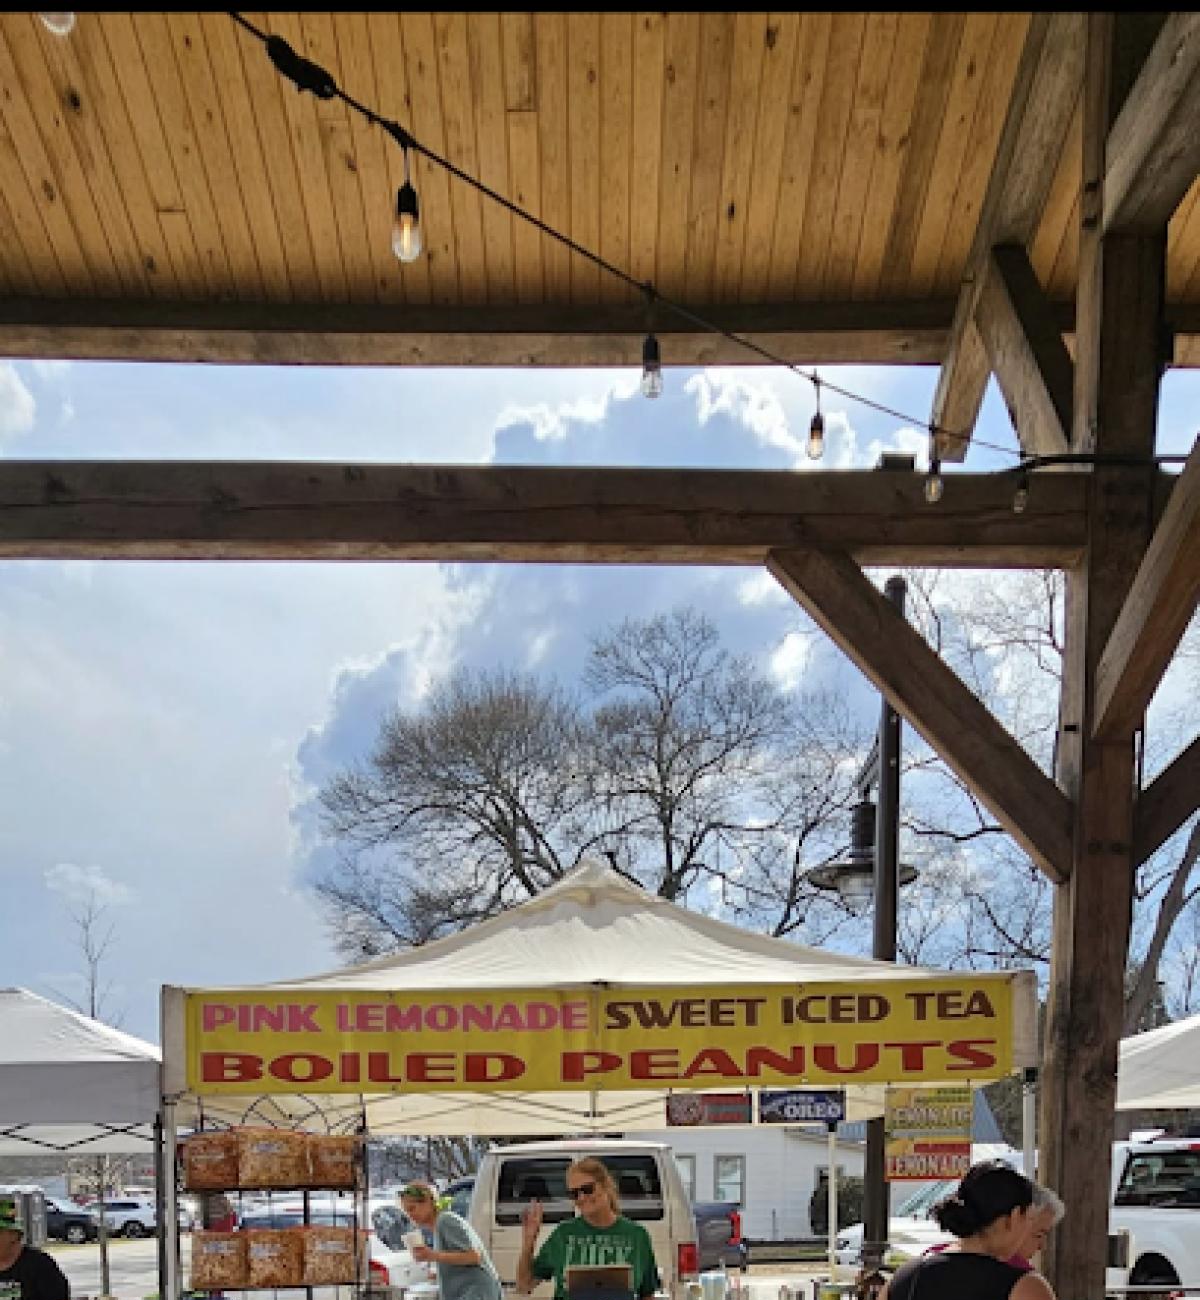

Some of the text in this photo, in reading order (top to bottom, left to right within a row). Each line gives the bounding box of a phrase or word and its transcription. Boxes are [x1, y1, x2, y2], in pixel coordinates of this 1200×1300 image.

[202, 990, 996, 1033] PINK LEMONADE SWEET ICED TEA
[202, 1039, 998, 1083] BOILED PEANUTS
[565, 1244, 633, 1266] LUCK
